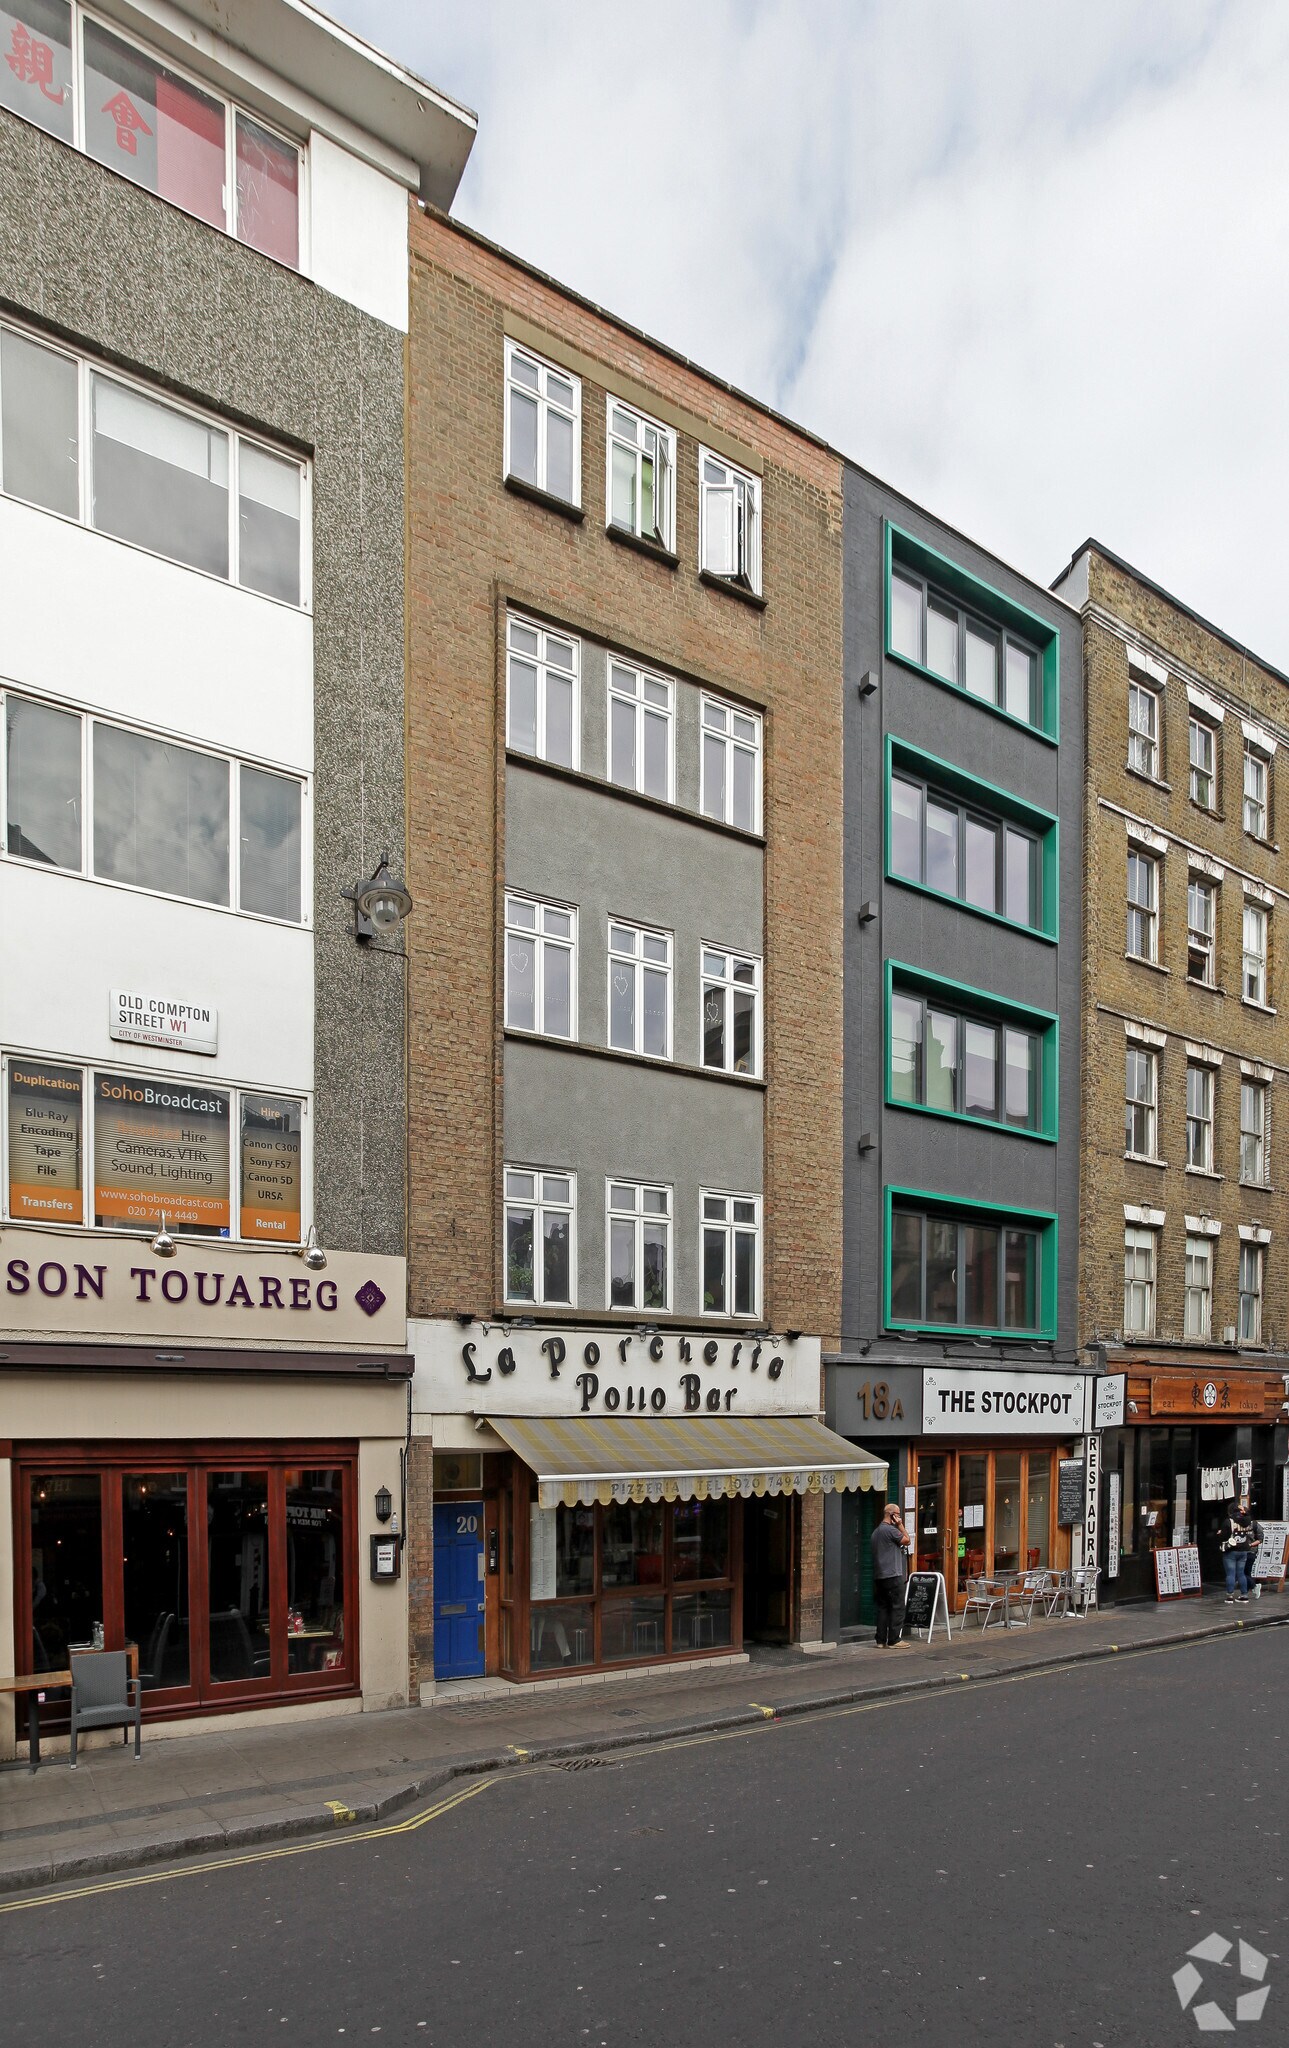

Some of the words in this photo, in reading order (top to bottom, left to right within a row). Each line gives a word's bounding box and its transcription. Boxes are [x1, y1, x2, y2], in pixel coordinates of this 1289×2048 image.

[101, 91, 153, 156] 會
[118, 994, 143, 1010] OLD
[149, 1000, 210, 1022] COMPTON
[118, 1010, 165, 1029] STREET
[170, 1019, 187, 1033] W1
[118, 1030, 132, 1038] CITY
[142, 1034, 183, 1046] WESTMINSTER
[13, 1072, 80, 1091] Duplication
[101, 1081, 222, 1114] SohoBroadcast
[25, 1107, 69, 1124] Blu-Ray
[260, 1107, 281, 1118] Hire
[21, 1124, 74, 1141] Encoding
[181, 1130, 207, 1143] Hire
[34, 1145, 61, 1158] Tape
[116, 1140, 175, 1159] Cameras,
[178, 1147, 208, 1162] VTRs
[243, 1139, 273, 1150] Canon
[275, 1142, 298, 1153] C300
[37, 1165, 57, 1176] File
[111, 1159, 157, 1177] Sound,
[160, 1164, 213, 1184] Lighting
[250, 1157, 273, 1169] Sony
[275, 1159, 292, 1169] FS7
[248, 1172, 278, 1184] Canon
[280, 1176, 293, 1185] 5D
[21, 1195, 73, 1210] Transfers
[100, 1190, 223, 1209] www.sohobroadcast.com
[257, 1190, 284, 1200] URSA
[127, 1206, 146, 1216] 020
[175, 1210, 198, 1221] 4449
[256, 1218, 286, 1230] Rental
[6, 1259, 107, 1298] SON
[130, 1267, 338, 1311] TOUAREG
[462, 1342, 516, 1382] La
[542, 1335, 784, 1379] Porchetta
[576, 1372, 666, 1411] Pollo
[680, 1373, 738, 1411] Bar
[857, 1381, 904, 1420] 18A
[938, 1390, 975, 1413] THE
[981, 1391, 1072, 1415] STOCKPOT
[1097, 1400, 1122, 1409] STOCKPOT
[1162, 1400, 1175, 1408] eat
[611, 1481, 680, 1495] PIZZERIA
[697, 1480, 727, 1491] TEL.
[734, 1478, 760, 1489] 020
[768, 1476, 800, 1488] 7494
[456, 1515, 478, 1534] 20
[1087, 1437, 1098, 1600] RESTAURA
